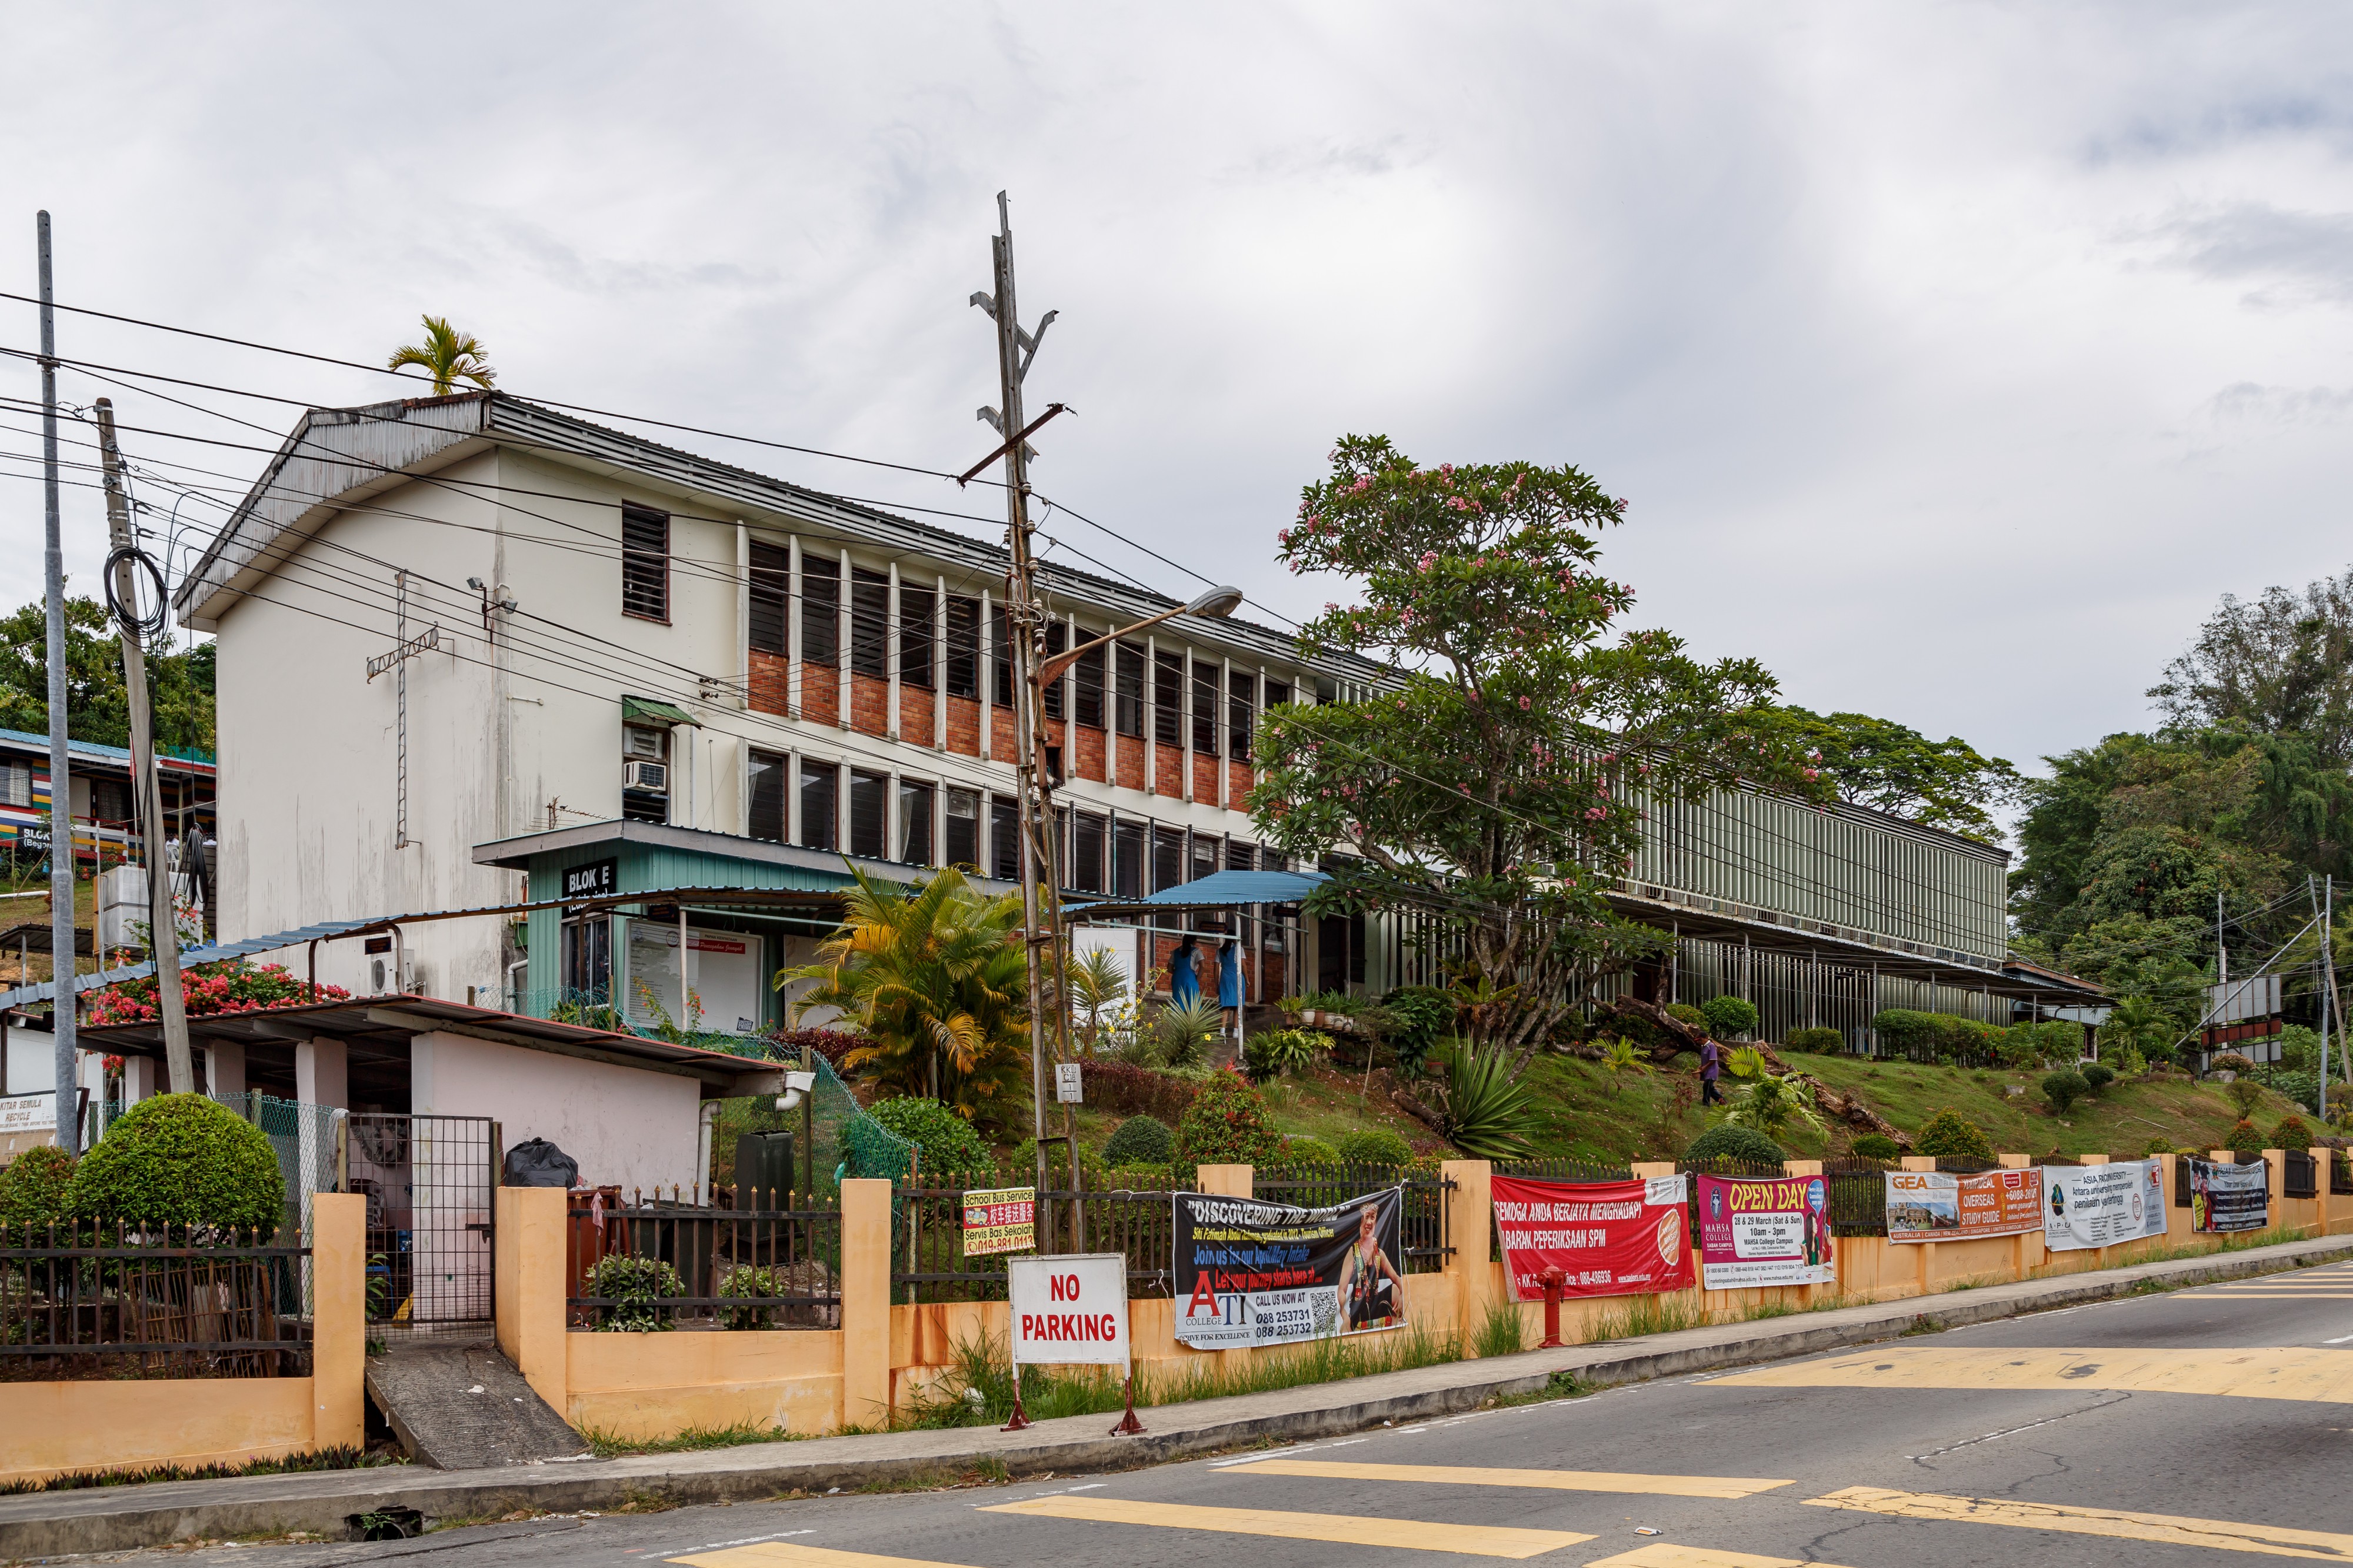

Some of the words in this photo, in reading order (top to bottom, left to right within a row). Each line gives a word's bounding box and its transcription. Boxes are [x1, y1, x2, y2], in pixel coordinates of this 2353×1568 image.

[569, 868, 596, 893] BLOK
[602, 865, 609, 885] E
[0, 1101, 17, 1111] KITAR
[19, 1099, 41, 1109] SEMULA
[5, 1112, 31, 1122] RECYCLE
[1892, 1176, 1928, 1189] GEA
[2083, 1175, 2098, 1185] ASIA
[965, 1193, 991, 1206] School
[992, 1193, 1005, 1203] Bus
[1006, 1190, 1033, 1202] Service
[1729, 1183, 1774, 1211] OPEN
[1777, 1183, 1807, 1210] DAY
[2072, 1187, 2089, 1196] Antara
[1963, 1193, 1995, 1207] OVERSEAS
[2074, 1197, 2100, 1211] penilaian
[989, 1203, 1034, 1226] 校车接送服务
[1281, 1208, 1308, 1225] THE
[1494, 1201, 1528, 1222] SEMOGA
[1528, 1203, 1552, 1222] ANDA
[1553, 1203, 1589, 1222] BERJAYA
[1590, 1201, 1642, 1220] MENGHADAPI
[1962, 1212, 1981, 1225] STUDY
[1982, 1210, 2000, 1223] GUIDE
[1705, 1223, 1730, 1233] MAHSA
[1734, 1217, 1741, 1225] 28
[1755, 1216, 1771, 1225] March
[1772, 1216, 1784, 1226] (Sat
[1785, 1216, 1789, 1224] &
[1790, 1216, 1802, 1226] Sun)
[965, 1229, 987, 1240] Servis
[989, 1227, 1002, 1238] Bas
[1004, 1224, 1034, 1237] Sekolah
[1192, 1227, 1204, 1240] Siti
[1204, 1227, 1227, 1241] Fatimah
[1301, 1227, 1319, 1240] Tourism
[1318, 1226, 1334, 1238] Officer
[1502, 1230, 1533, 1250] BARAN
[1533, 1229, 1587, 1250] PEPERIKSAAN
[1588, 1229, 1606, 1248] SPM
[1750, 1227, 1767, 1236] 10am
[1772, 1227, 1786, 1237] 3pm
[1776, 1237, 1793, 1246] Campus
[1194, 1245, 1215, 1265] Join
[1216, 1250, 1227, 1265] us
[1229, 1245, 1240, 1263] for
[1241, 1250, 1254, 1265] our
[1287, 1244, 1309, 1263] Intake
[1215, 1269, 1230, 1289] Let
[1230, 1273, 1247, 1293] your
[1248, 1269, 1272, 1292] journey
[1273, 1267, 1292, 1287] starts
[1291, 1266, 1308, 1285] here
[1308, 1265, 1315, 1283] at
[1522, 1273, 1531, 1287] KK
[1579, 1270, 1611, 1285] 088-486936
[1051, 1274, 1080, 1302] NO
[1256, 1295, 1271, 1307] CALL
[1272, 1293, 1280, 1306] US
[1282, 1292, 1296, 1305] NOW
[1298, 1292, 1306, 1303] AT
[1186, 1317, 1222, 1326] COLLEGE
[1256, 1312, 1274, 1325] 088
[1276, 1309, 1310, 1323] 253731
[1022, 1313, 1116, 1342] PARKING
[1256, 1326, 1274, 1338] 088
[1277, 1322, 1311, 1336] 253732
[1215, 1332, 1250, 1340] EXCELLENCE
